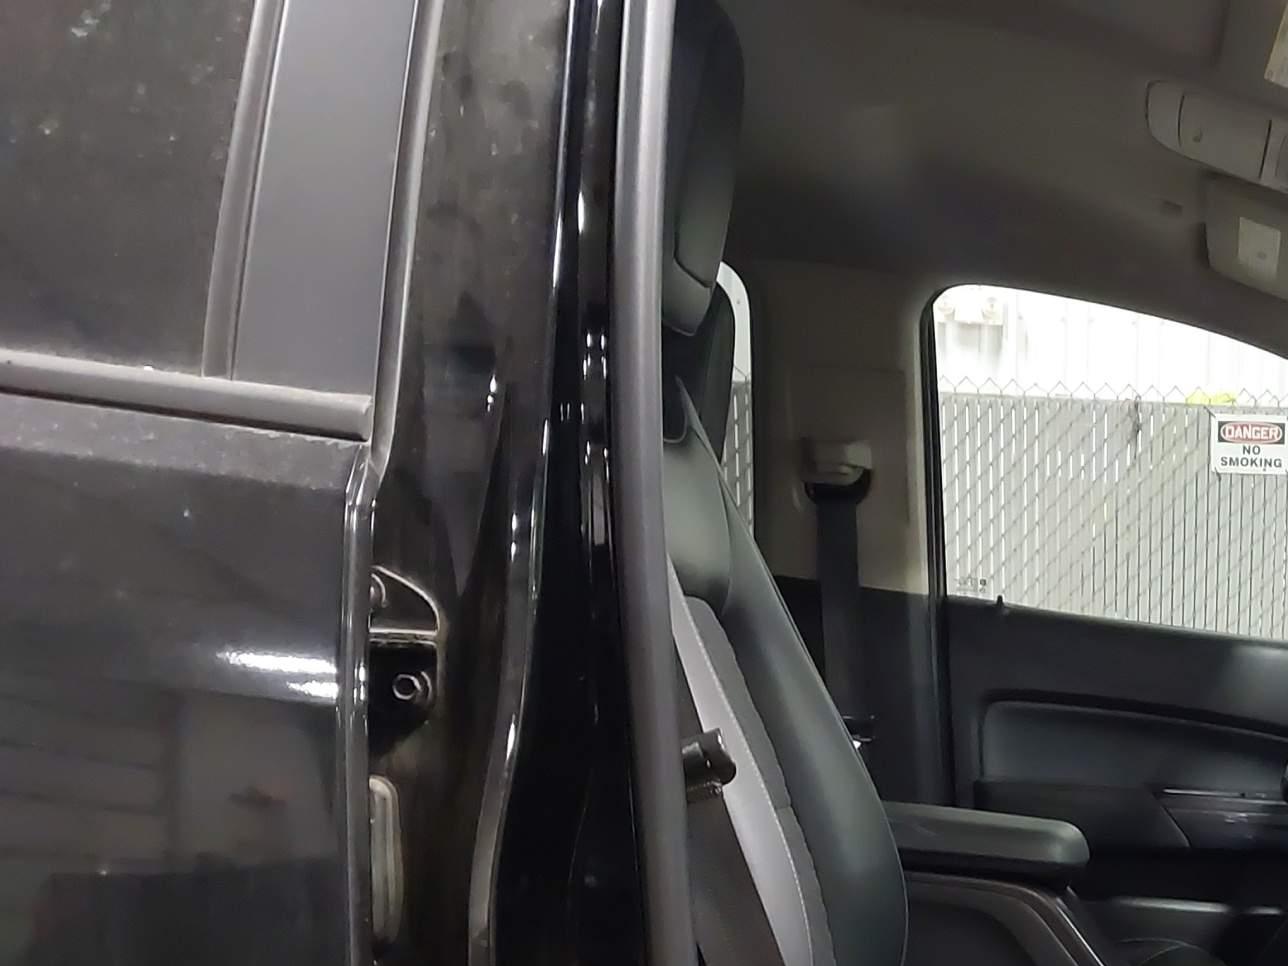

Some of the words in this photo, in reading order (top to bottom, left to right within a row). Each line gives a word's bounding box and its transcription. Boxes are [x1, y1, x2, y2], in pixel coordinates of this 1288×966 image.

[1225, 424, 1279, 440] DANGER
[1242, 445, 1261, 455] NO
[1220, 456, 1283, 468] SMOKING
